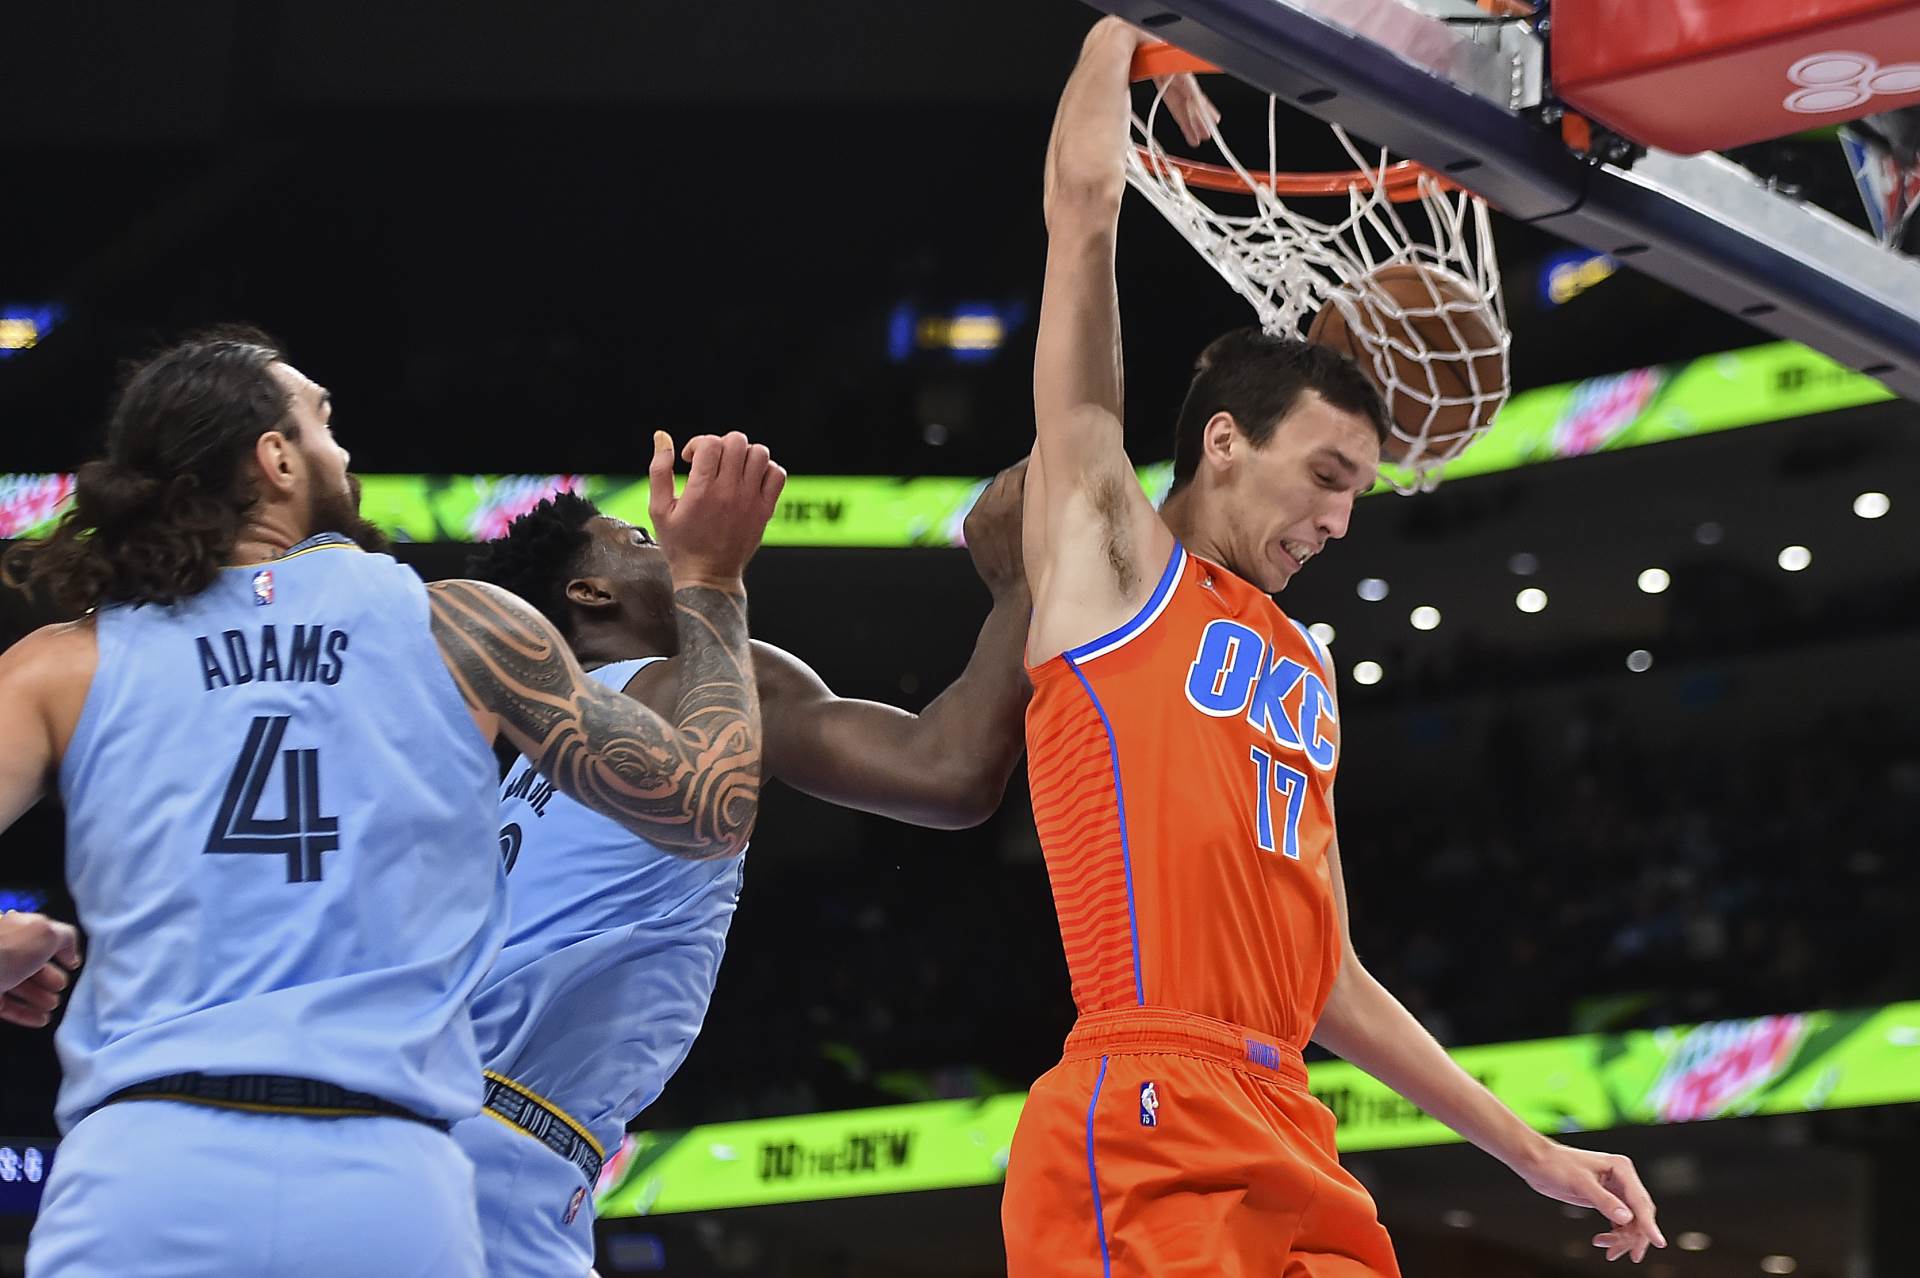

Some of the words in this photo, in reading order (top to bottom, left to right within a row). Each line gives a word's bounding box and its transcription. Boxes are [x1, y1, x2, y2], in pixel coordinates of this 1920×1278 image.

[195, 624, 349, 691] ADAMS
[1184, 618, 1337, 771] OKC
[202, 715, 340, 884] 4
[1250, 744, 1308, 861] 17
